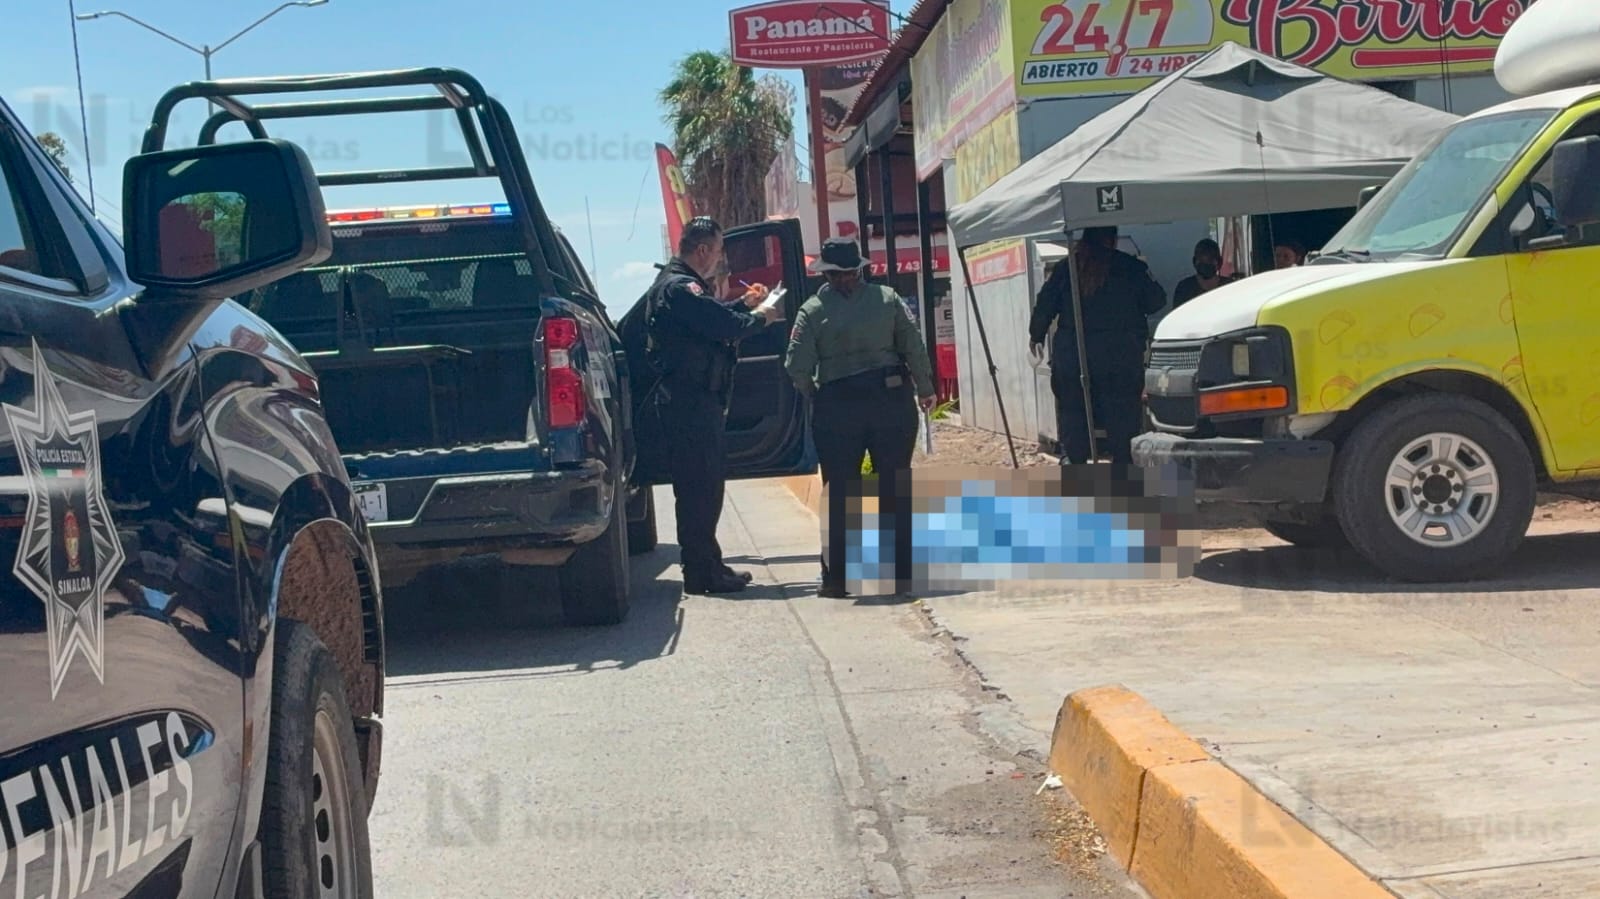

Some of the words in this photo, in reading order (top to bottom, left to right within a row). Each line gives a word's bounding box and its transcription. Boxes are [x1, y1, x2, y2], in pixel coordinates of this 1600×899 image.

[744, 9, 875, 40] Panamá
[750, 45, 812, 56] Restaurante
[814, 45, 821, 53] y
[1027, 62, 1099, 79] ABIERTO
[1129, 58, 1153, 74] 24
[61, 450, 85, 464] ESTATAL
[58, 576, 92, 595] SINALOA
[0, 711, 193, 899] ENALES
